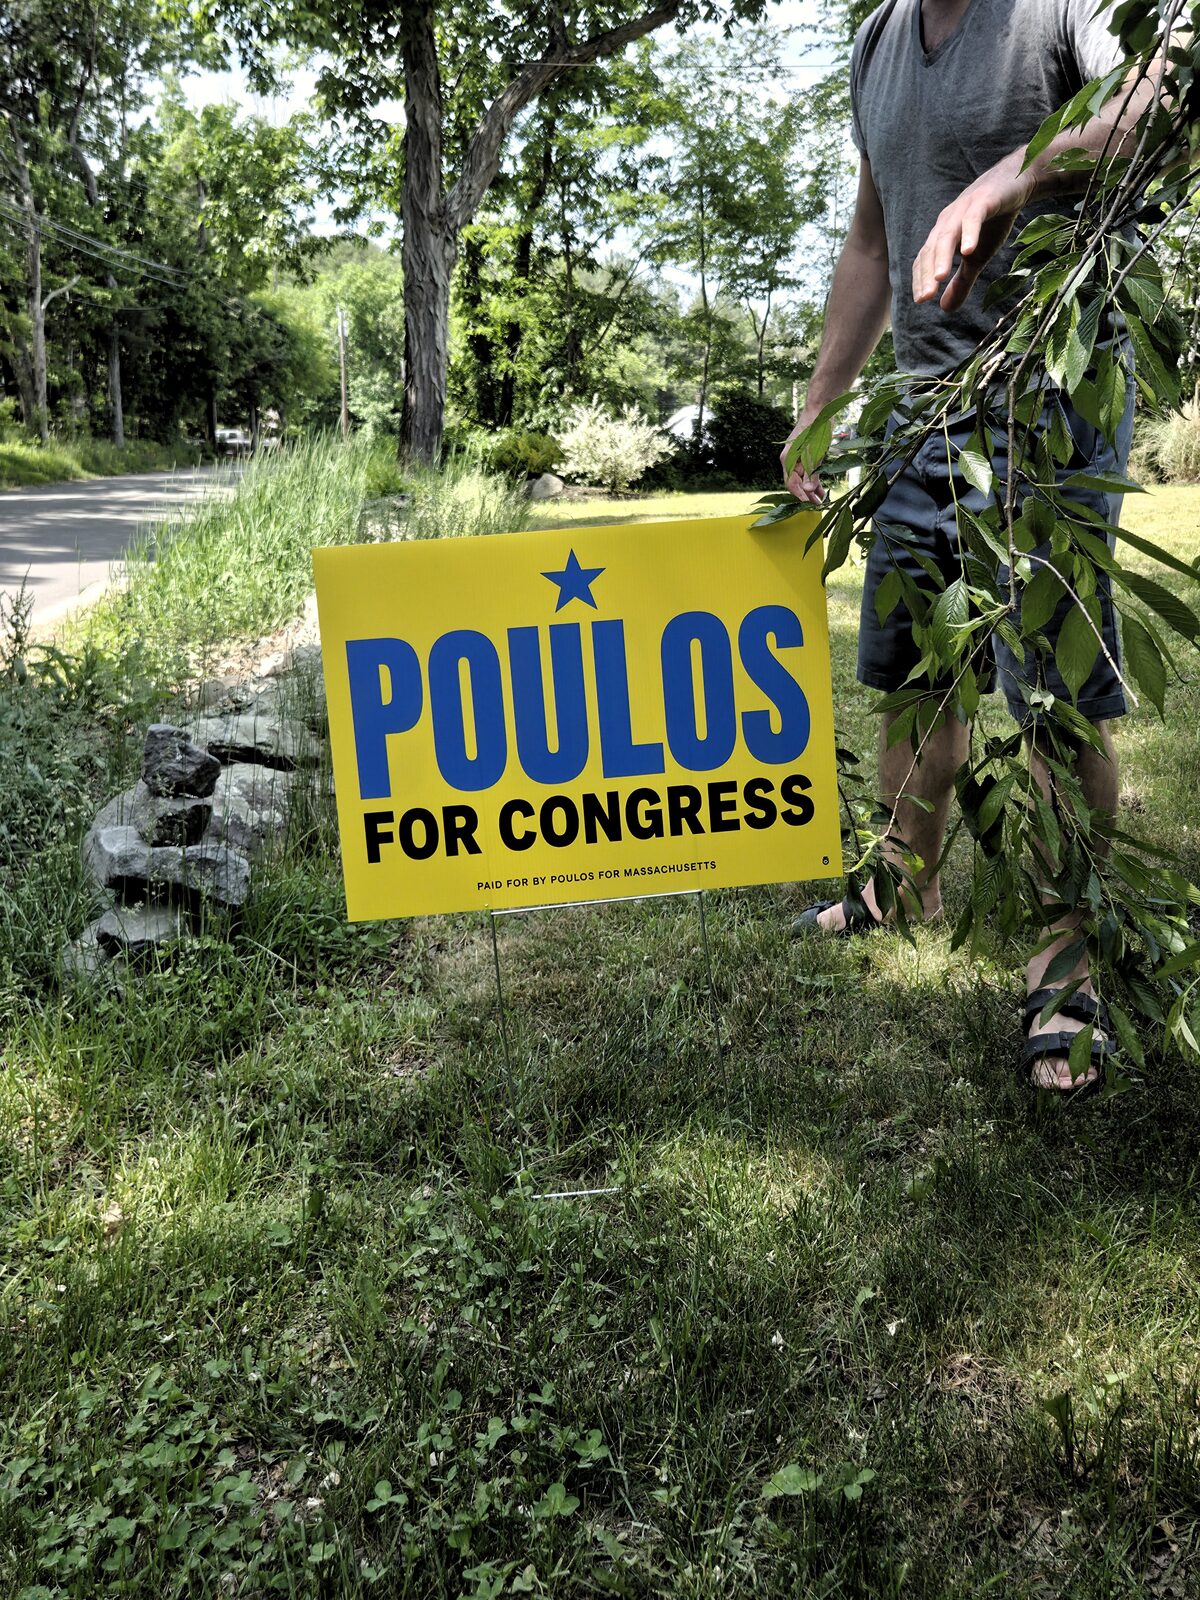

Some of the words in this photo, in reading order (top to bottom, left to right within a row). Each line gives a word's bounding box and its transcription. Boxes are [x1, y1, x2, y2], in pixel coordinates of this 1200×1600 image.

[346, 605, 811, 800] POULOS
[363, 805, 482, 864] FOR
[499, 774, 815, 852] CONGRESS
[477, 880, 502, 890] PAID
[507, 878, 528, 888] FOR
[533, 876, 546, 886] BY
[551, 872, 594, 884] POULOS
[599, 870, 620, 880] FOR
[624, 861, 717, 877] MASSACHUSETTS
